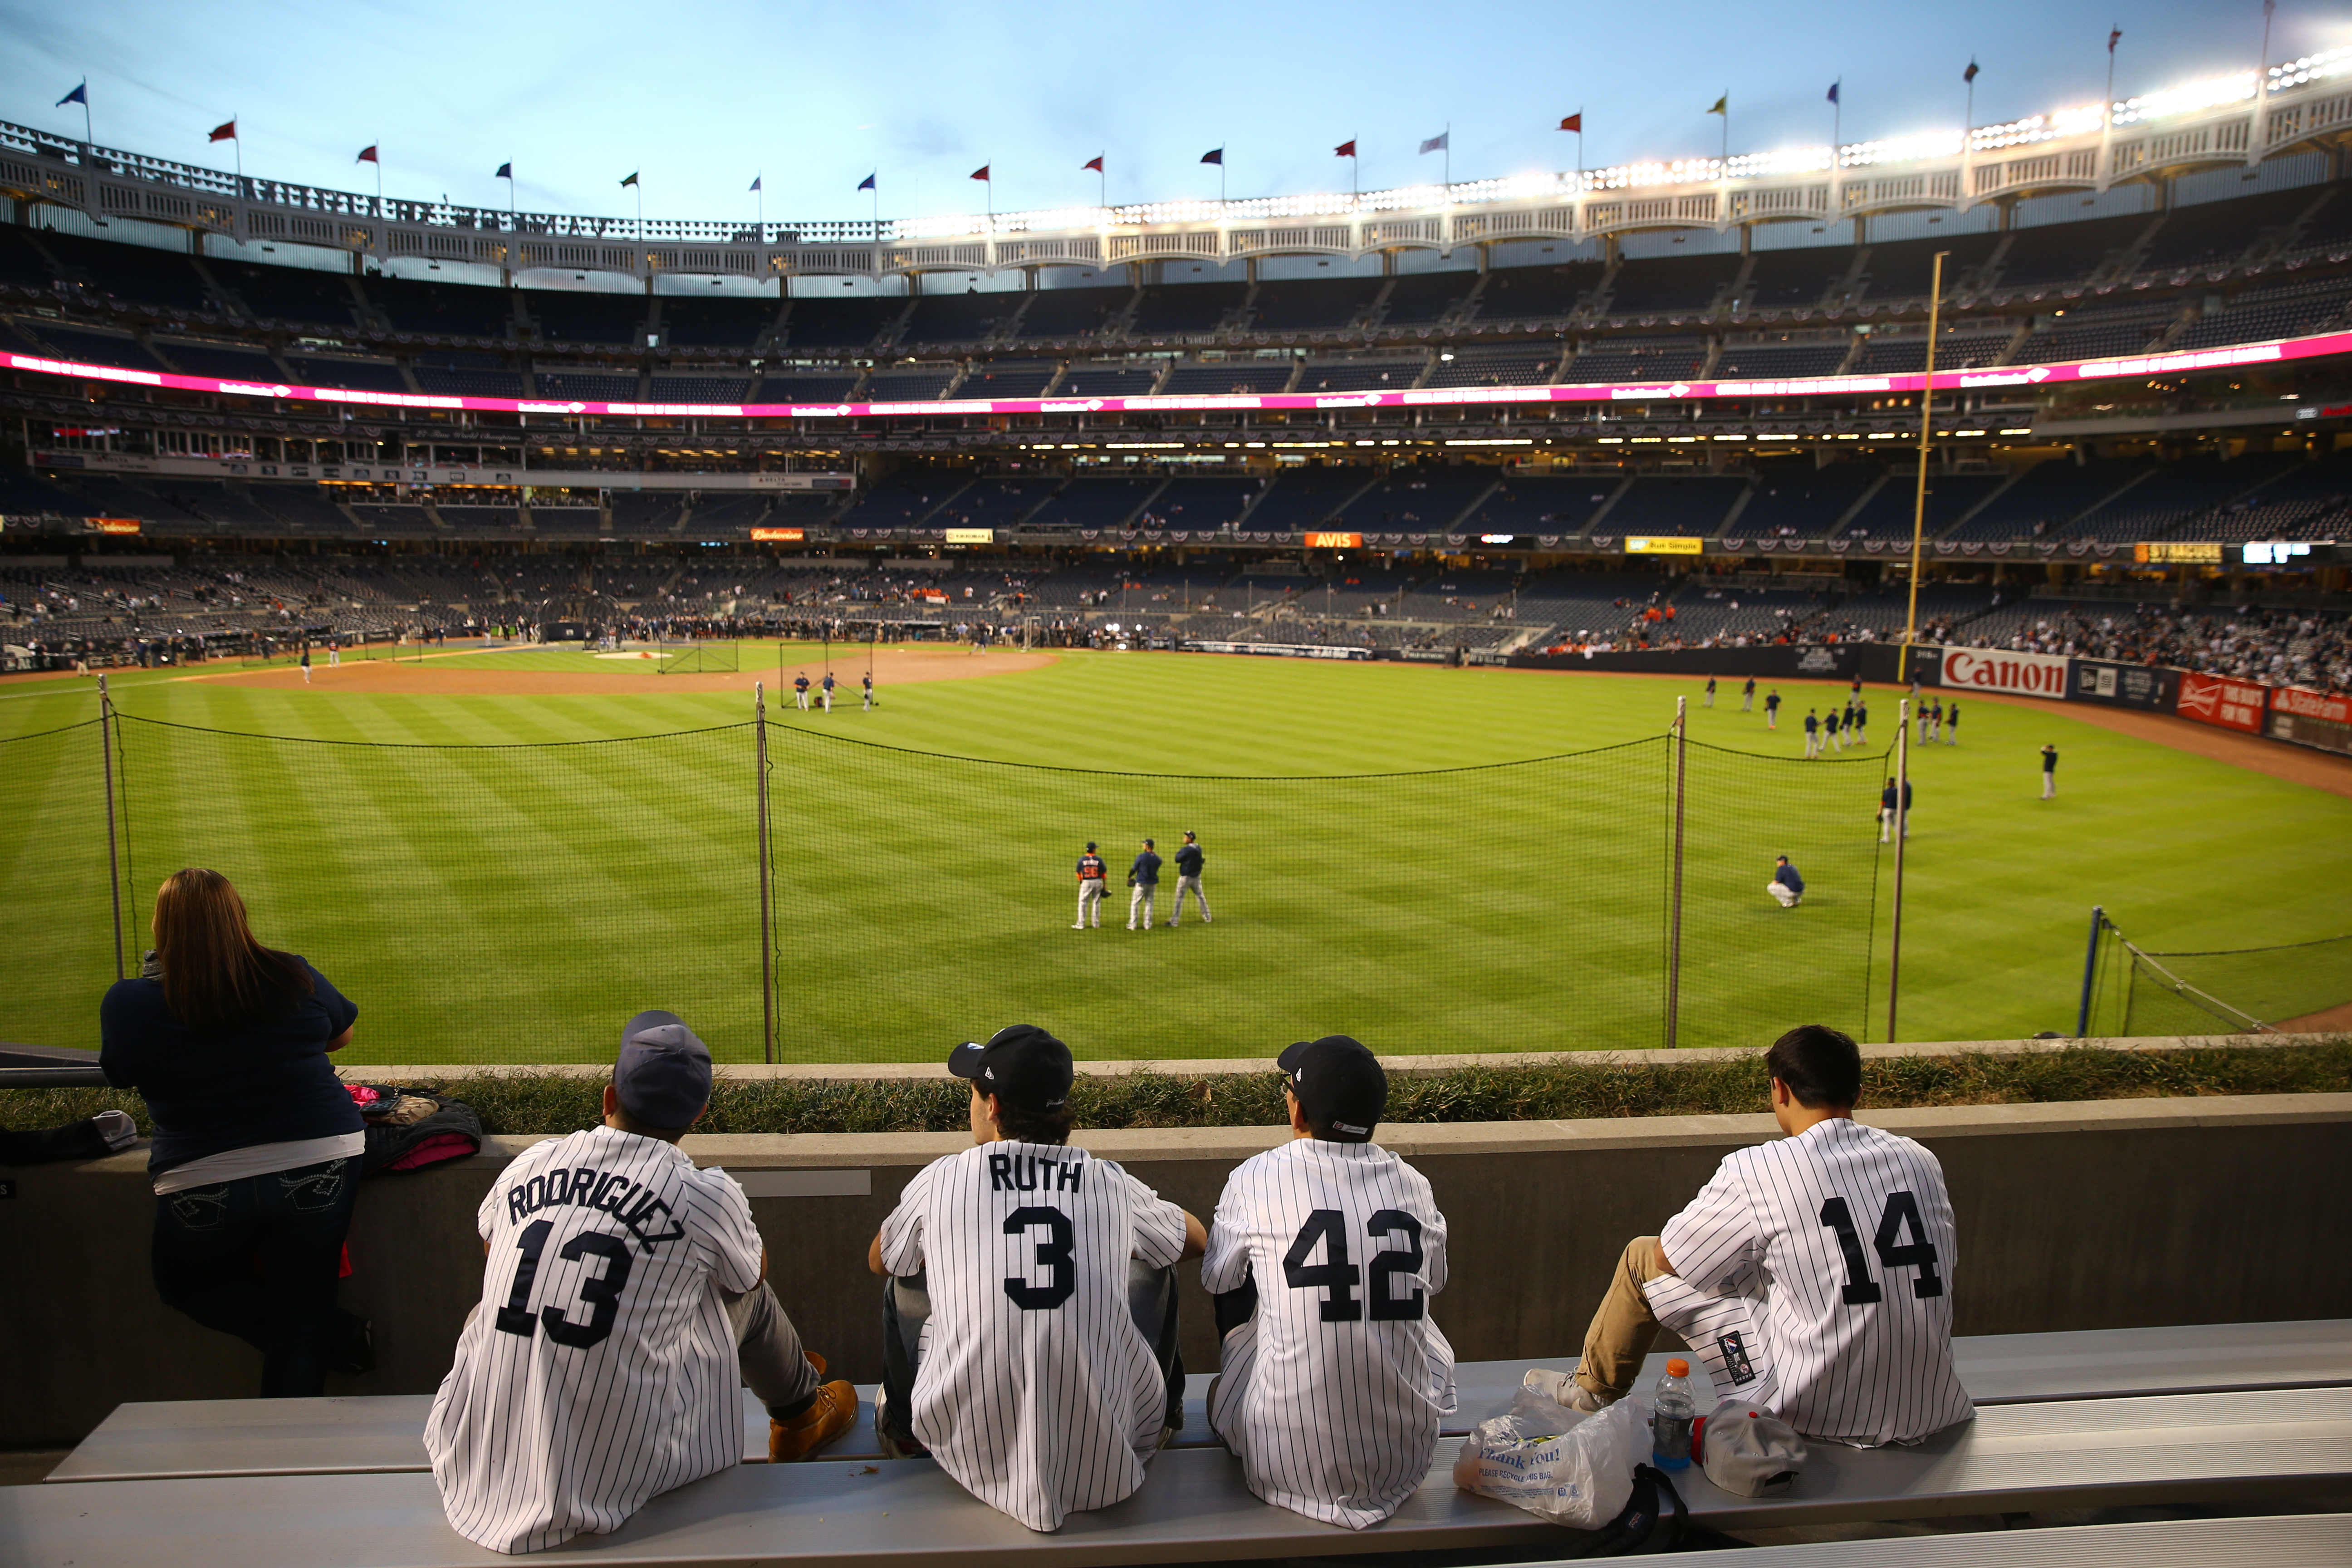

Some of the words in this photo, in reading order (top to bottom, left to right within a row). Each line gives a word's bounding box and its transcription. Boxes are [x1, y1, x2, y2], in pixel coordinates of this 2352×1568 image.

[2322, 405, 2352, 417] Aud
[415, 430, 450, 439] 27-Time
[453, 431, 479, 440] World
[479, 432, 520, 442] Champions
[752, 529, 804, 540] Budweiser
[1315, 533, 1352, 548] AVIS
[1945, 652, 2063, 693] Canon
[1084, 866, 1098, 878] 96
[988, 1153, 1082, 1193] RUTH
[0, 1184, 7, 1195] S
[508, 1168, 686, 1254] RODRIGUEZ
[1003, 1206, 1075, 1310] 3
[1819, 1191, 1943, 1305] 14
[1283, 1209, 1424, 1322] 42
[495, 1219, 633, 1350] 13
[1477, 1447, 1526, 1470] Thank
[1530, 1448, 1560, 1465] You!
[1479, 1468, 1498, 1477] PLEASE
[1499, 1470, 1525, 1482] RECYCLE
[1539, 1471, 1553, 1480] BAG.
